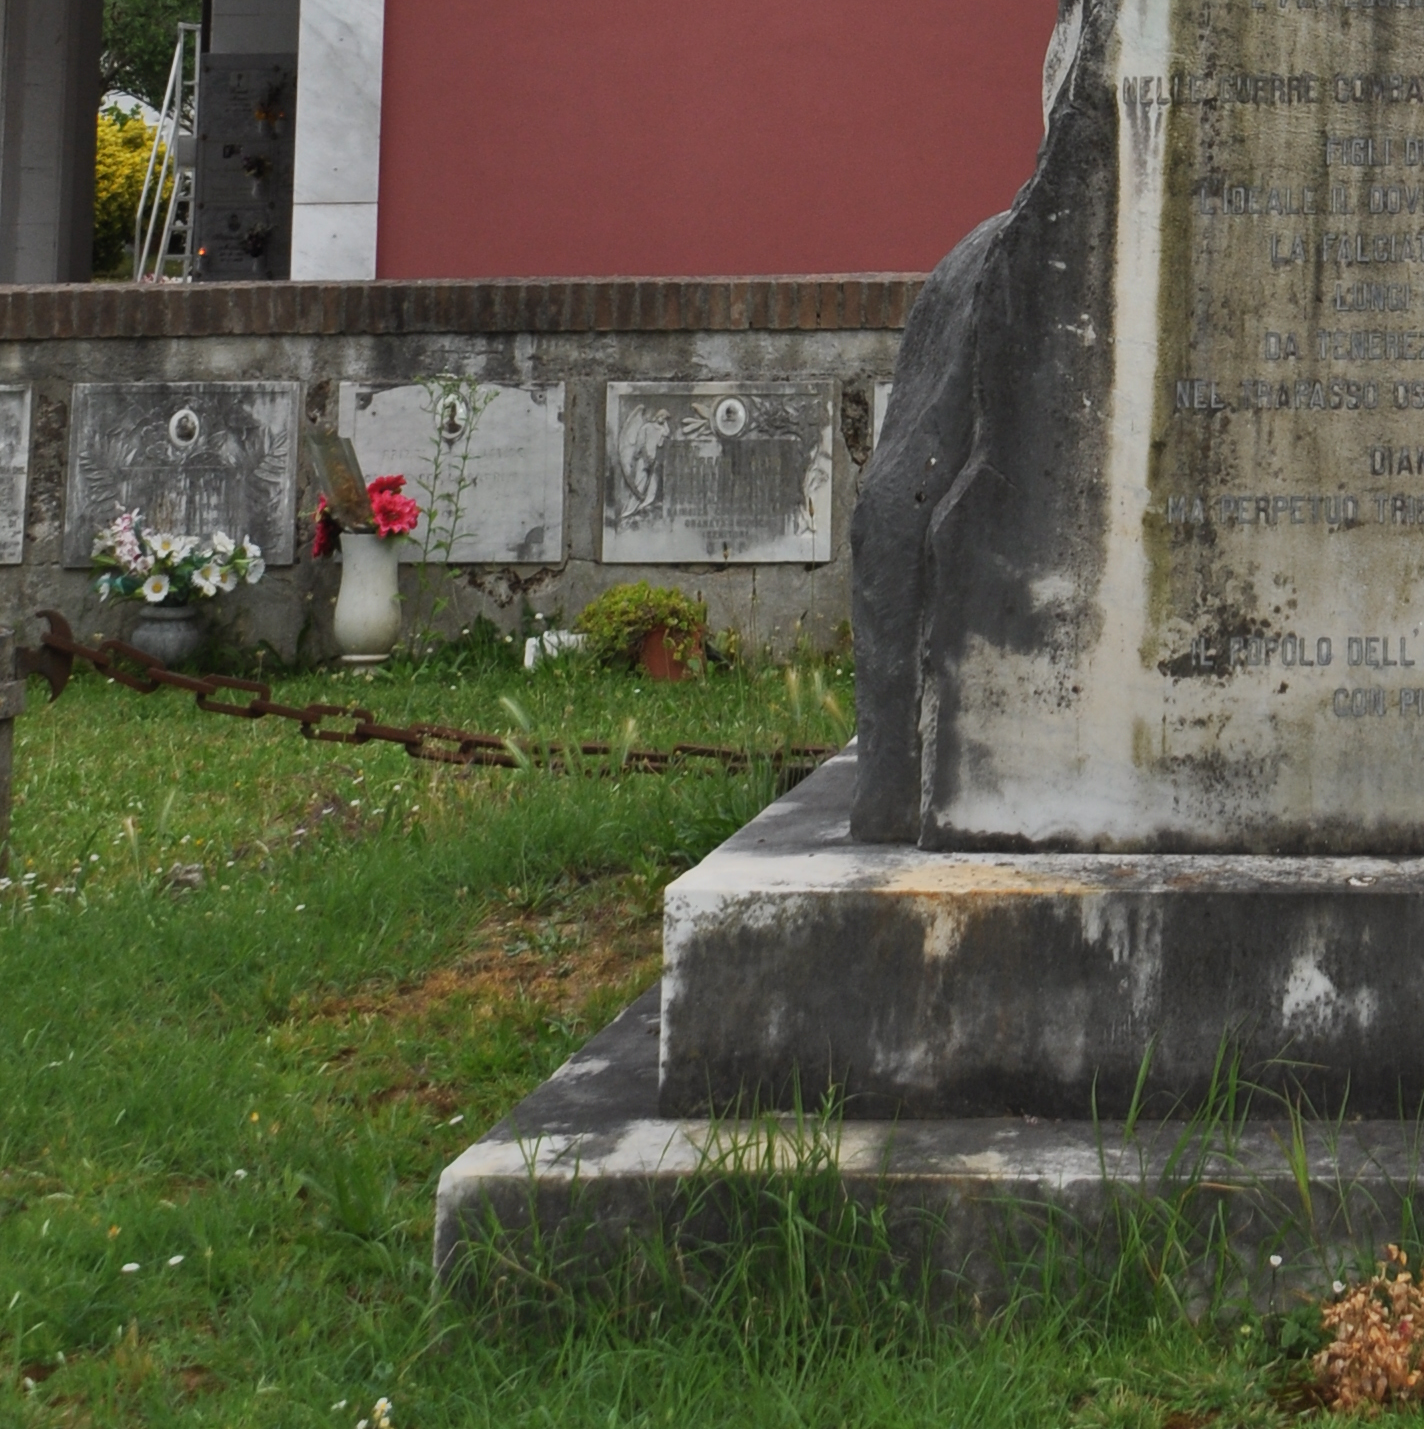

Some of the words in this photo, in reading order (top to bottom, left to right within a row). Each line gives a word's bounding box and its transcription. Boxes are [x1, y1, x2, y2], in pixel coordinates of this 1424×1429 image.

[1122, 73, 1204, 104] NELLE
[1218, 73, 1320, 104] GUERRE
[1325, 138, 1392, 166] FIGLI
[1332, 185, 1353, 215] IL
[1271, 233, 1308, 263] LA
[1334, 282, 1411, 311] LUNGI
[1264, 330, 1300, 360] DA
[1174, 379, 1227, 409] NEL
[1240, 379, 1380, 409] TRAPASSO
[1166, 495, 1206, 525] MA
[1218, 495, 1359, 525] PERPETUO
[1190, 637, 1214, 667] IL
[1228, 637, 1333, 667] POPOLO
[1332, 687, 1388, 718] CON
